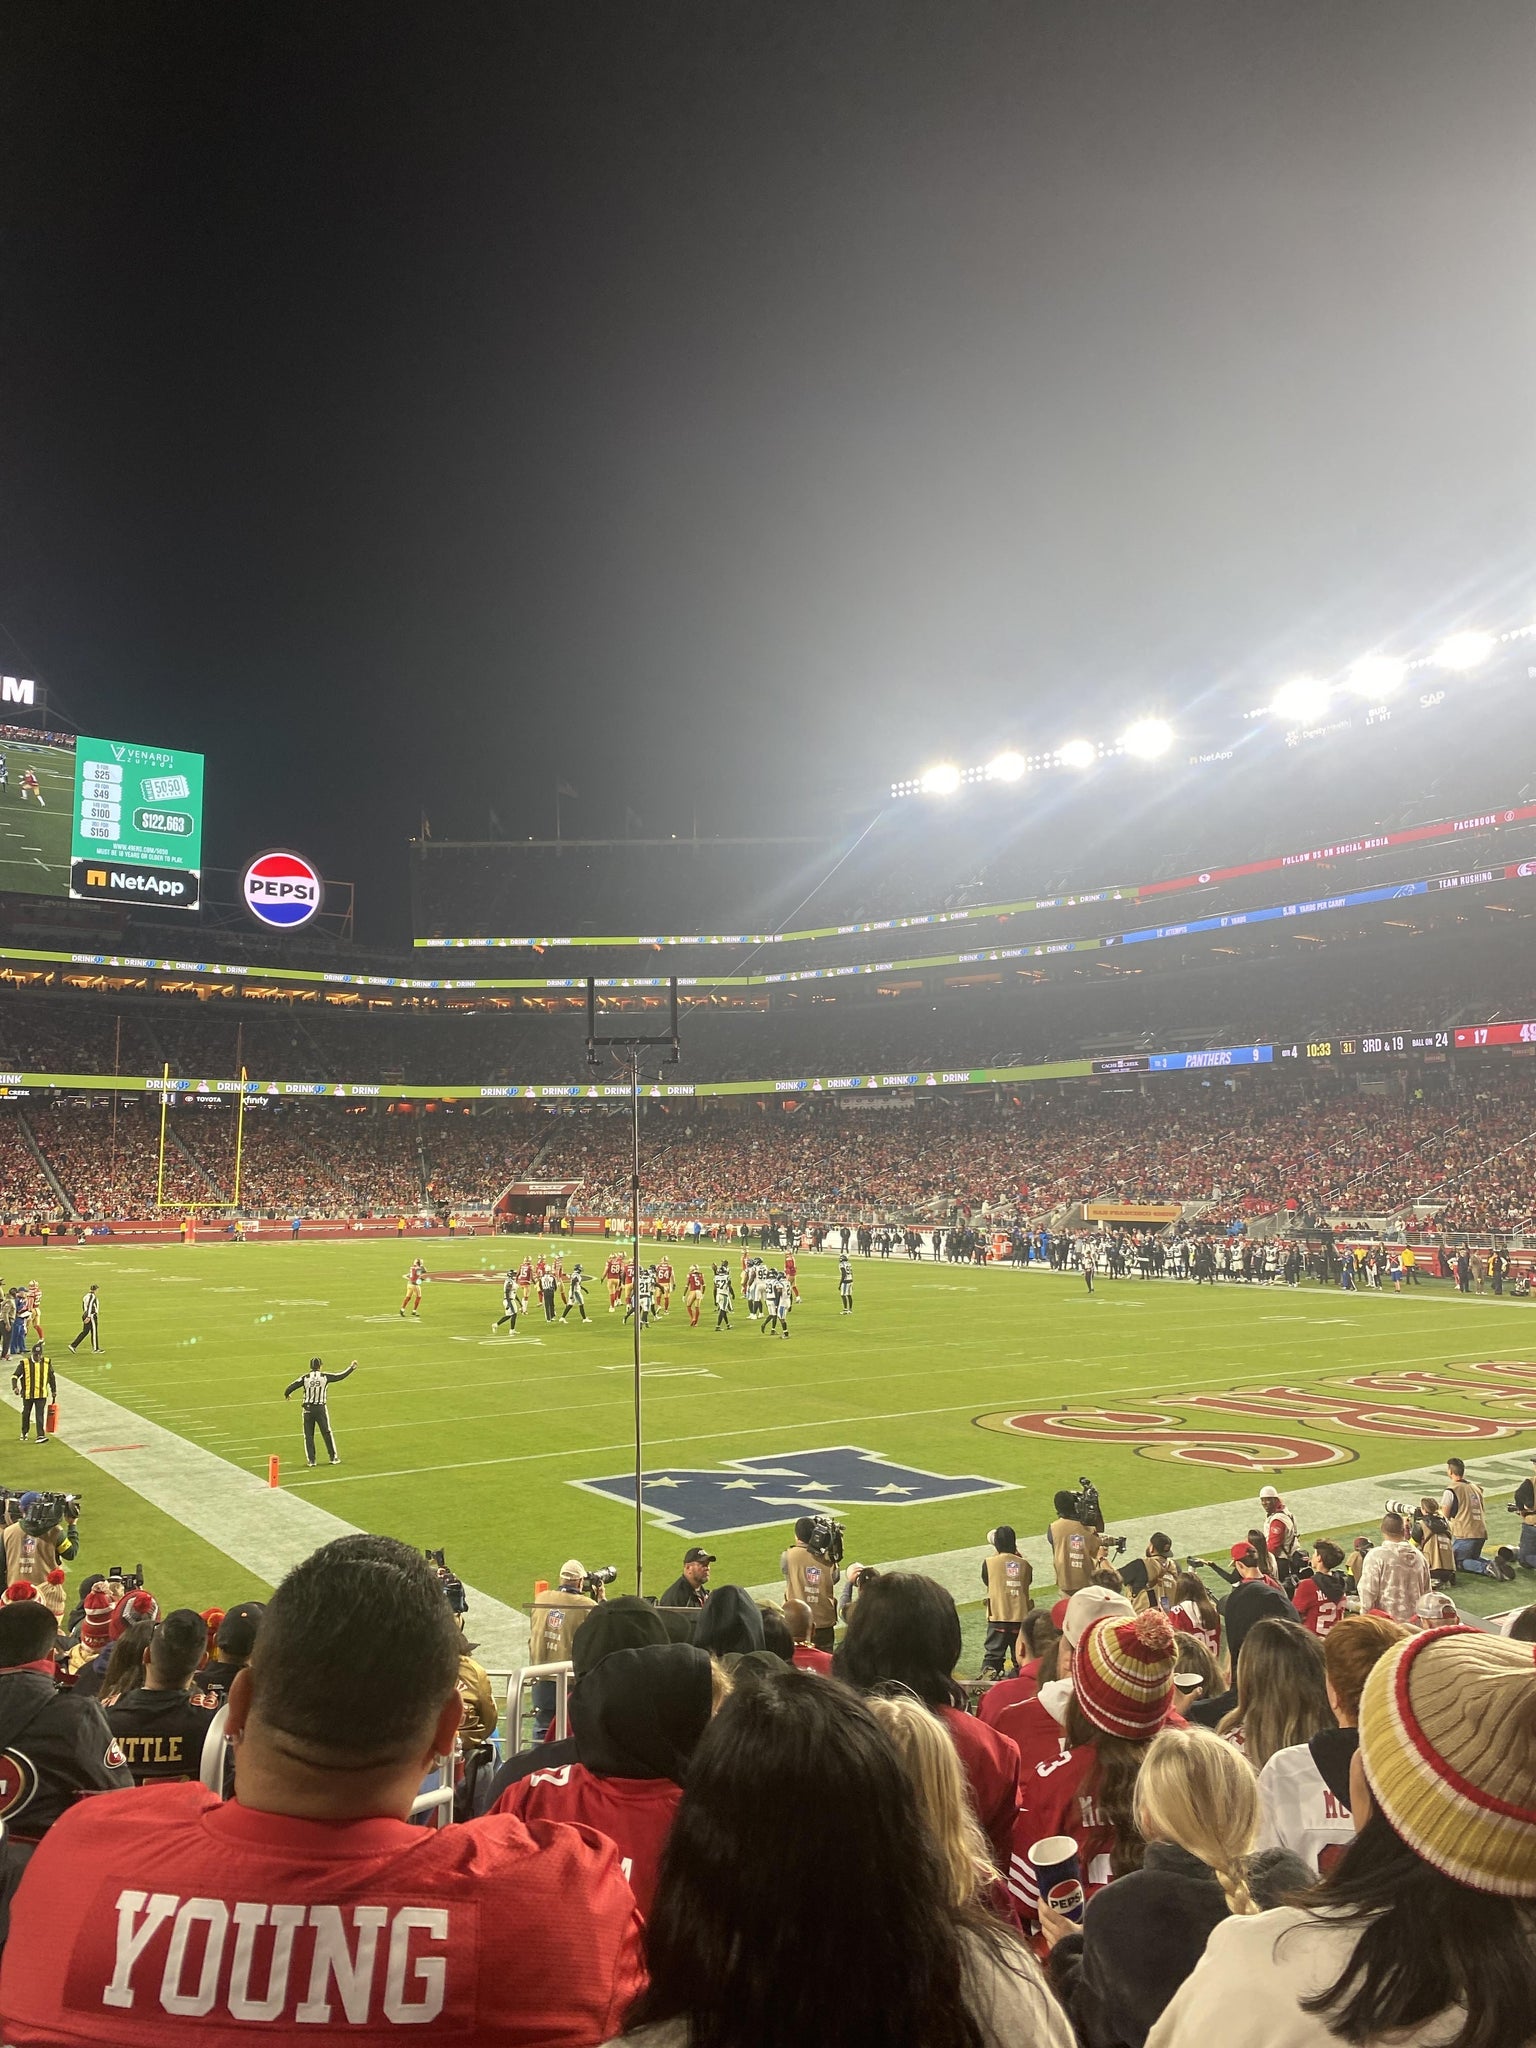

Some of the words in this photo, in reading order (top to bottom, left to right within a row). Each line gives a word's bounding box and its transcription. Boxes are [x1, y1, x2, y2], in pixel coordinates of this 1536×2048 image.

[1420, 690, 1445, 708] SAP
[1368, 705, 1387, 717] BUD
[1366, 712, 1391, 726] LIHT
[128, 749, 174, 763] VENARDI
[1199, 751, 1233, 763] NetApp
[95, 770, 110, 780] $25
[94, 789, 109, 799] $49
[91, 808, 110, 819] $100
[142, 812, 184, 832] $122,663
[1454, 815, 1496, 831] FACEBOOK
[91, 827, 109, 838] $150
[1282, 853, 1309, 866] FOLLOW
[1313, 851, 1322, 860] US
[1324, 849, 1333, 857] ON
[1336, 842, 1362, 855] SOCIAL
[1365, 836, 1389, 848] MEDIA
[110, 872, 184, 896] NetApp
[1439, 878, 1457, 889] TEAM
[1460, 872, 1492, 885] RUSHING
[249, 880, 314, 900] PEPSI
[1299, 903, 1316, 913] YARDS
[1317, 901, 1328, 910] PER
[1328, 899, 1346, 908] CARRY
[950, 911, 968, 919] DRINK
[226, 966, 248, 974] DRINK
[875, 963, 893, 971] DRINK
[1412, 1039, 1424, 1047] BALL
[1425, 1038, 1433, 1046] ON
[1435, 1032, 1448, 1047] 24
[1474, 1029, 1488, 1044] 17
[1306, 1043, 1331, 1057] 10:33
[1343, 1043, 1352, 1053] 31
[1362, 1038, 1382, 1052] 3RD
[1384, 1042, 1390, 1051] &
[1392, 1036, 1403, 1050] 19
[1185, 1052, 1232, 1067] PANTHERS
[1253, 1049, 1259, 1061] 9
[1291, 1046, 1297, 1058] 4
[0, 1074, 23, 1084] RINK
[942, 1073, 970, 1083] DRINK
[352, 1086, 379, 1095] DRINK
[667, 1086, 695, 1095] DRINK
[611, 1265, 620, 1273] 68
[658, 1270, 669, 1279] 64
[695, 1277, 700, 1286] 5
[716, 1280, 726, 1289] 57
[640, 1283, 649, 1293] 21
[310, 1379, 321, 1387] 99
[549, 1617, 562, 1626] NFL
[118, 1736, 183, 1762] ITTLE
[102, 1890, 448, 2025] YOUNG
